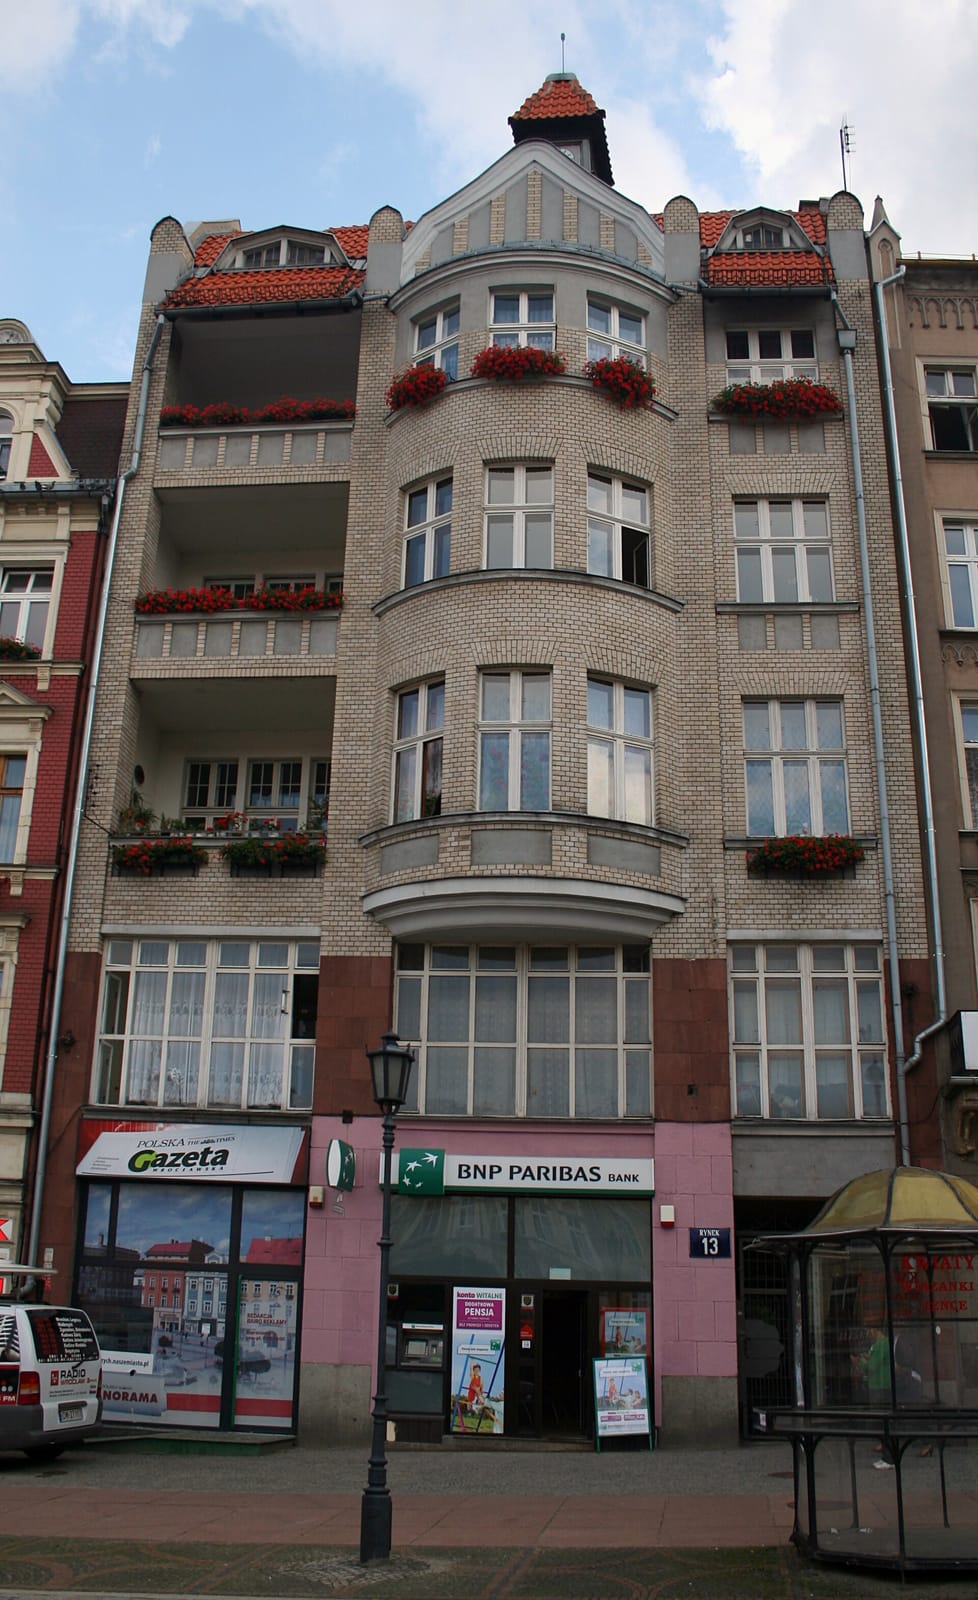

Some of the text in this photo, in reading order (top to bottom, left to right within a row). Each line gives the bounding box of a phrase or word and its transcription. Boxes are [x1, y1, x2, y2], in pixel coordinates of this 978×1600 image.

[137, 1138, 185, 1148] POLSKA
[128, 1146, 230, 1172] Gazeta
[457, 1164, 640, 1183] BNP PARIBAS BANK
[702, 1237, 719, 1255] 13
[457, 1291, 475, 1299] konto
[464, 1308, 494, 1317] PENSJA
[60, 1369, 86, 1378] RADIO
[103, 1390, 158, 1403] NORAMA
